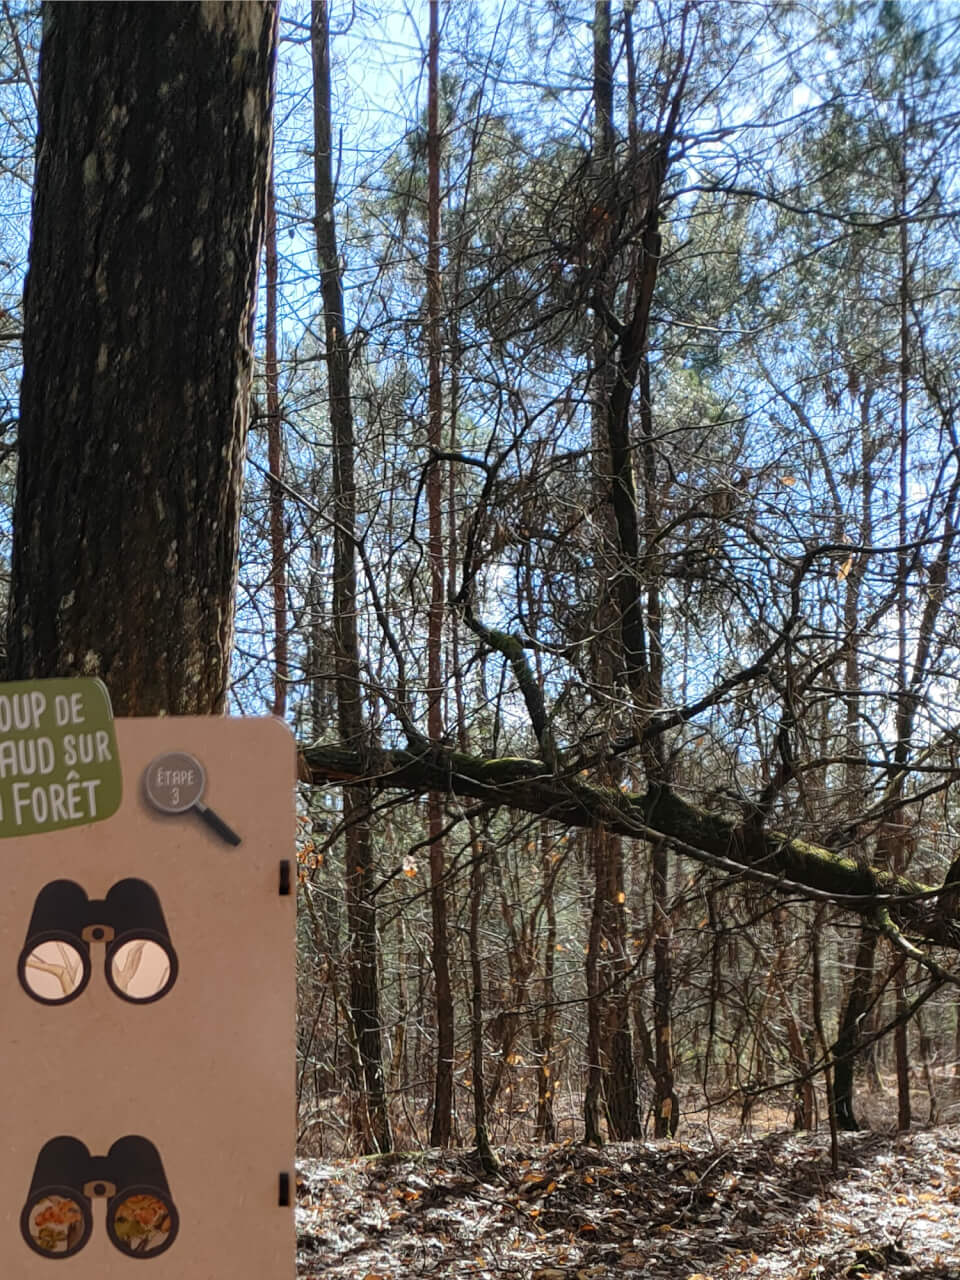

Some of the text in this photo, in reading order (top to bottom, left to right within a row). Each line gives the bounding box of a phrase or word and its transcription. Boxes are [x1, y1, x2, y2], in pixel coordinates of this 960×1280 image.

[55, 693, 85, 726] DE
[64, 731, 113, 766] SUR
[13, 770, 101, 825] FORÊT
[171, 787, 180, 805] 3
